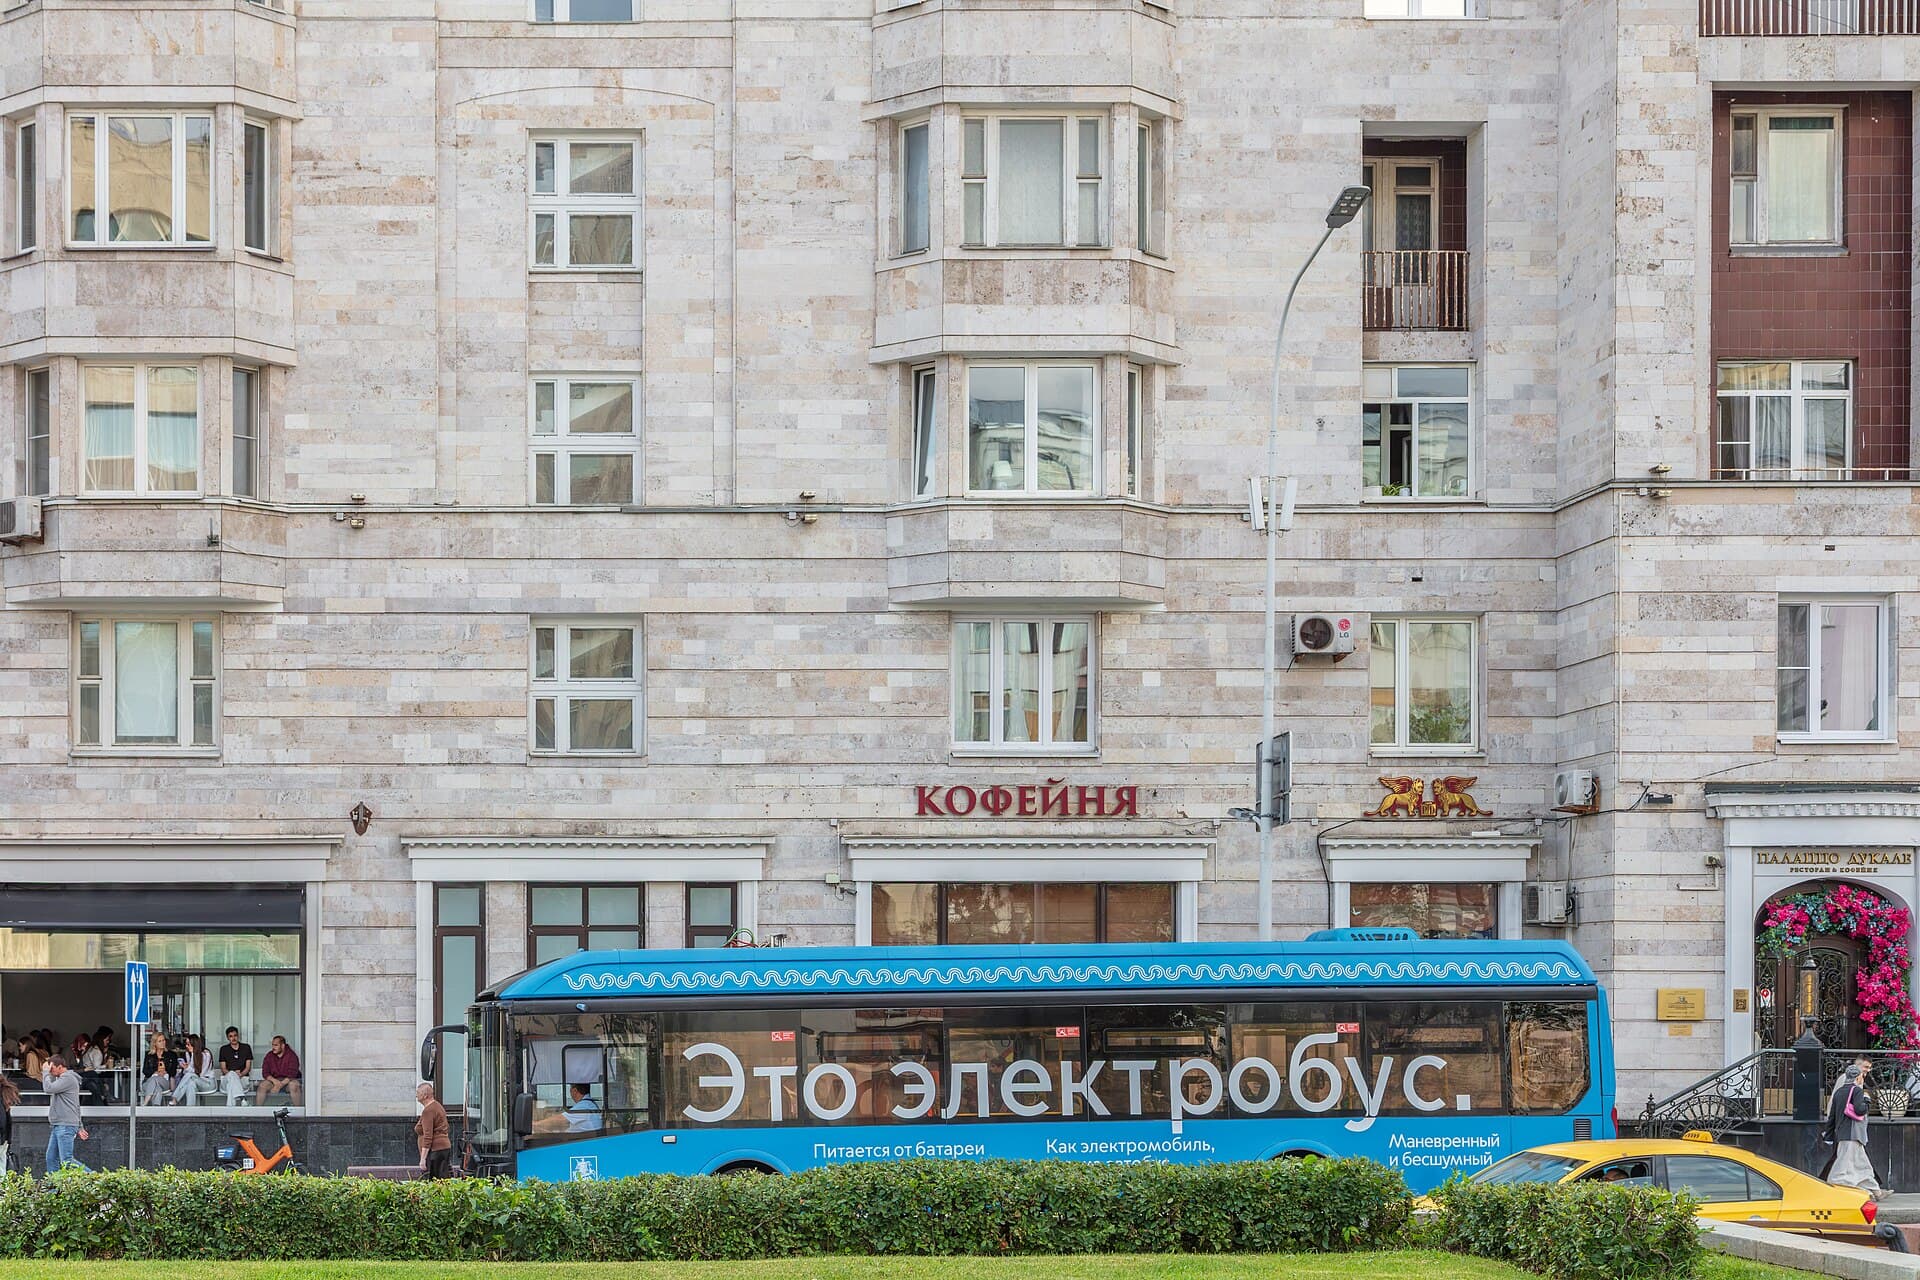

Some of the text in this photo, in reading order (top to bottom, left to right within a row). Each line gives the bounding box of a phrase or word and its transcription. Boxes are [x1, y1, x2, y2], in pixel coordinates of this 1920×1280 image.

[915, 777, 1138, 816] КОФЕЙНЯ
[1757, 852, 1912, 865] ПАЛАЦЦО ДУКАЛЕ
[682, 1032, 1471, 1134] Это электробус.
[814, 1141, 985, 1159] Питается от батареи
[1046, 1136, 1215, 1155] Как электромобиль,
[1388, 1132, 1500, 1151] Маневренный
[1389, 1152, 1493, 1169] и бесшумный
